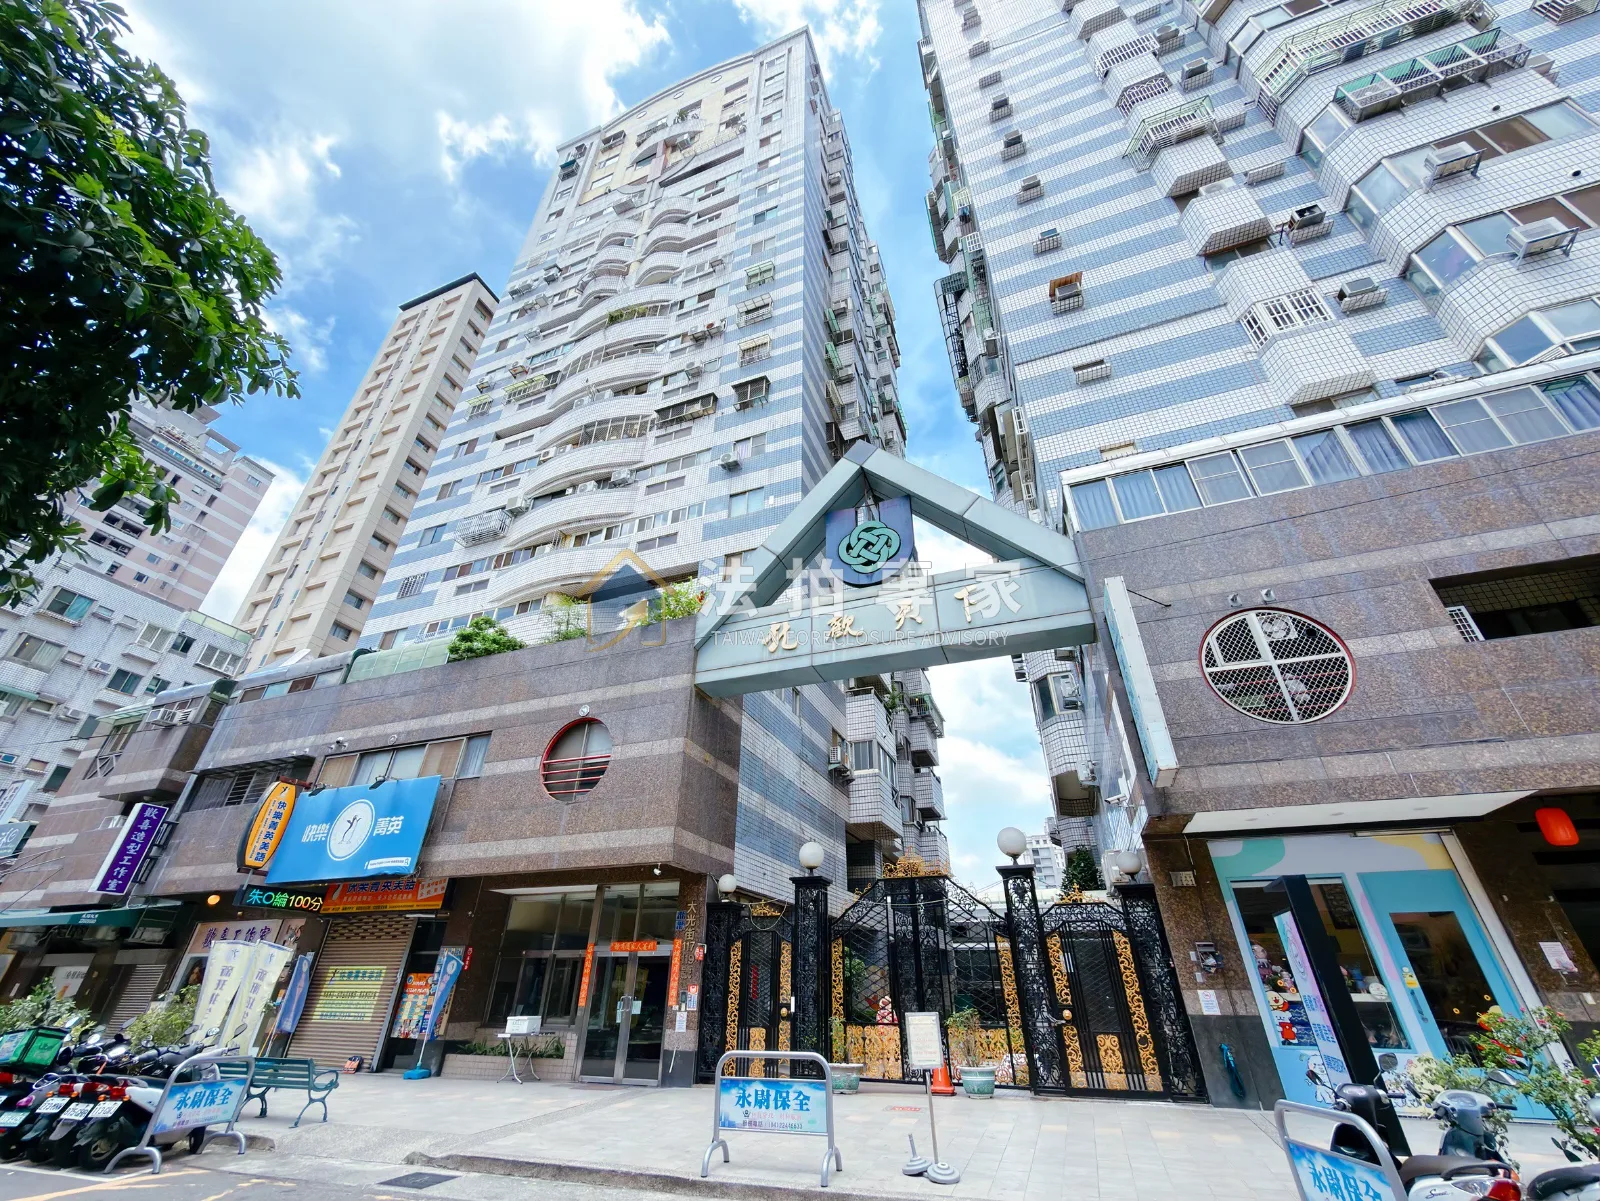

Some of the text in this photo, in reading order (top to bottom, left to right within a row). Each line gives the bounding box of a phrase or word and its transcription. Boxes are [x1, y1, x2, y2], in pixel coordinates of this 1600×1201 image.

[254, 800, 287, 862] 快樂菁英美語
[302, 817, 404, 842] 快樂 菁英
[105, 806, 159, 891] 歡喜造型工作室
[176, 1088, 233, 1110] 永尉保全
[735, 1088, 811, 1112] 永尉保全
